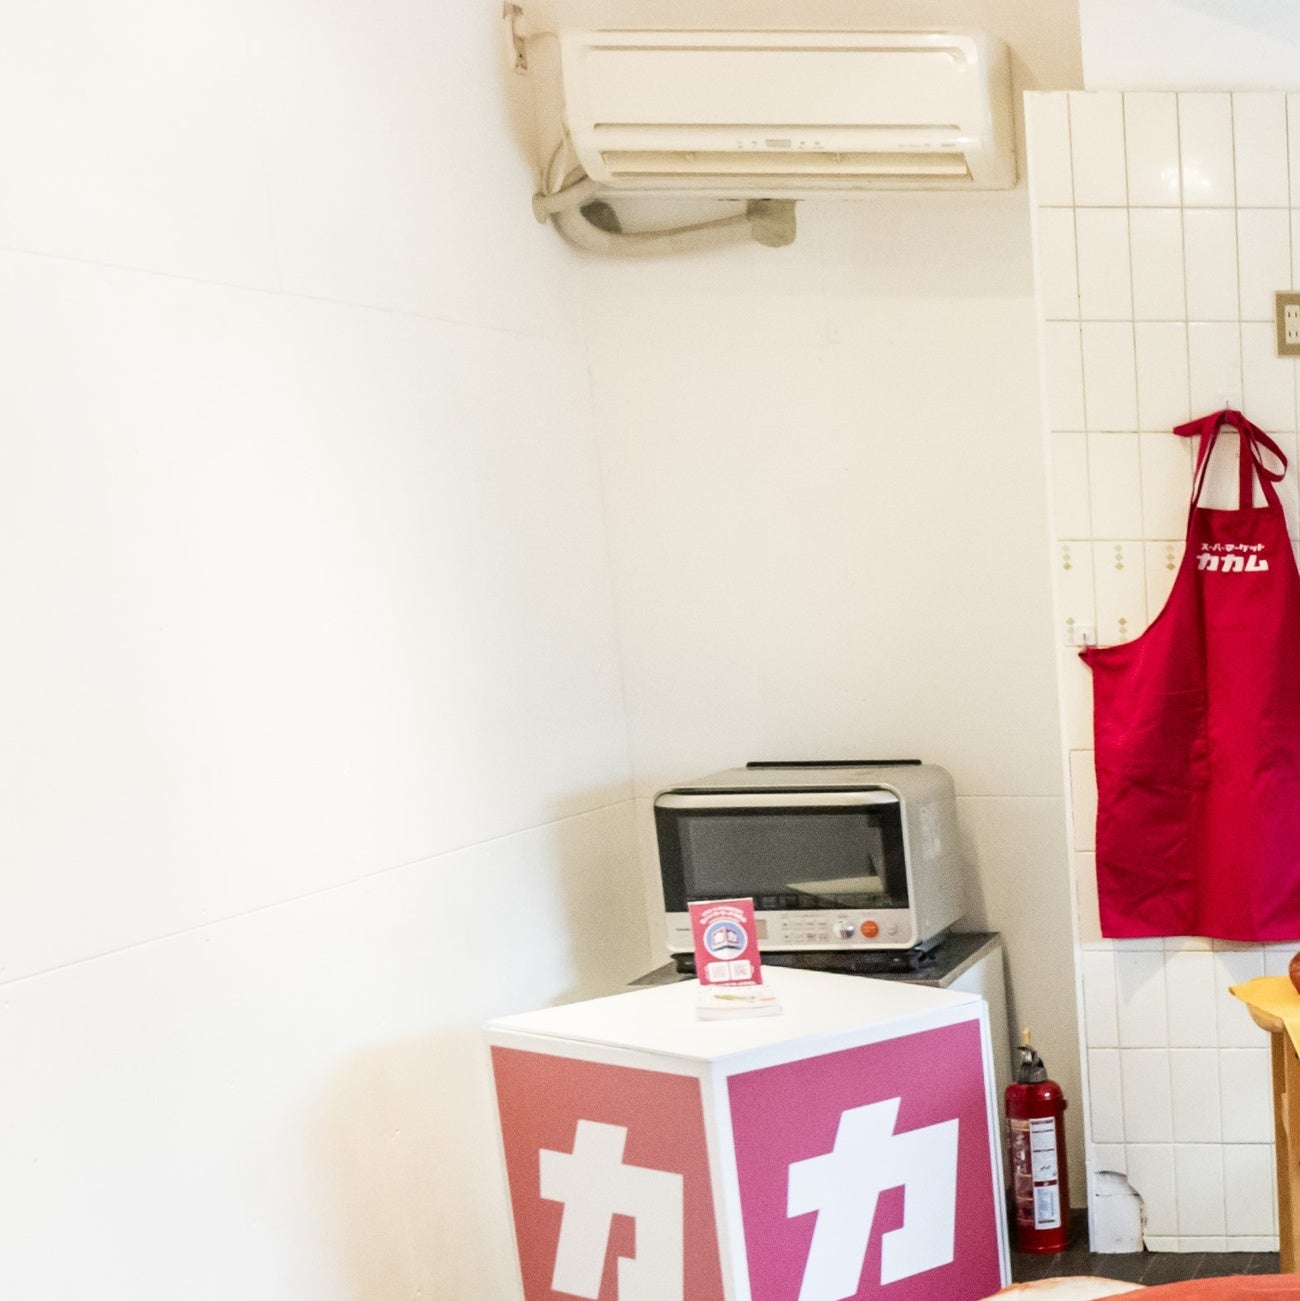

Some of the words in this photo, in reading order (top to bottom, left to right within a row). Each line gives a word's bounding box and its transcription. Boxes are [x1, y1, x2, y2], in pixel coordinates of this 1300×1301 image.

[1200, 543, 1265, 553] スーパーマーケット
[1196, 552, 1270, 573] カカム
